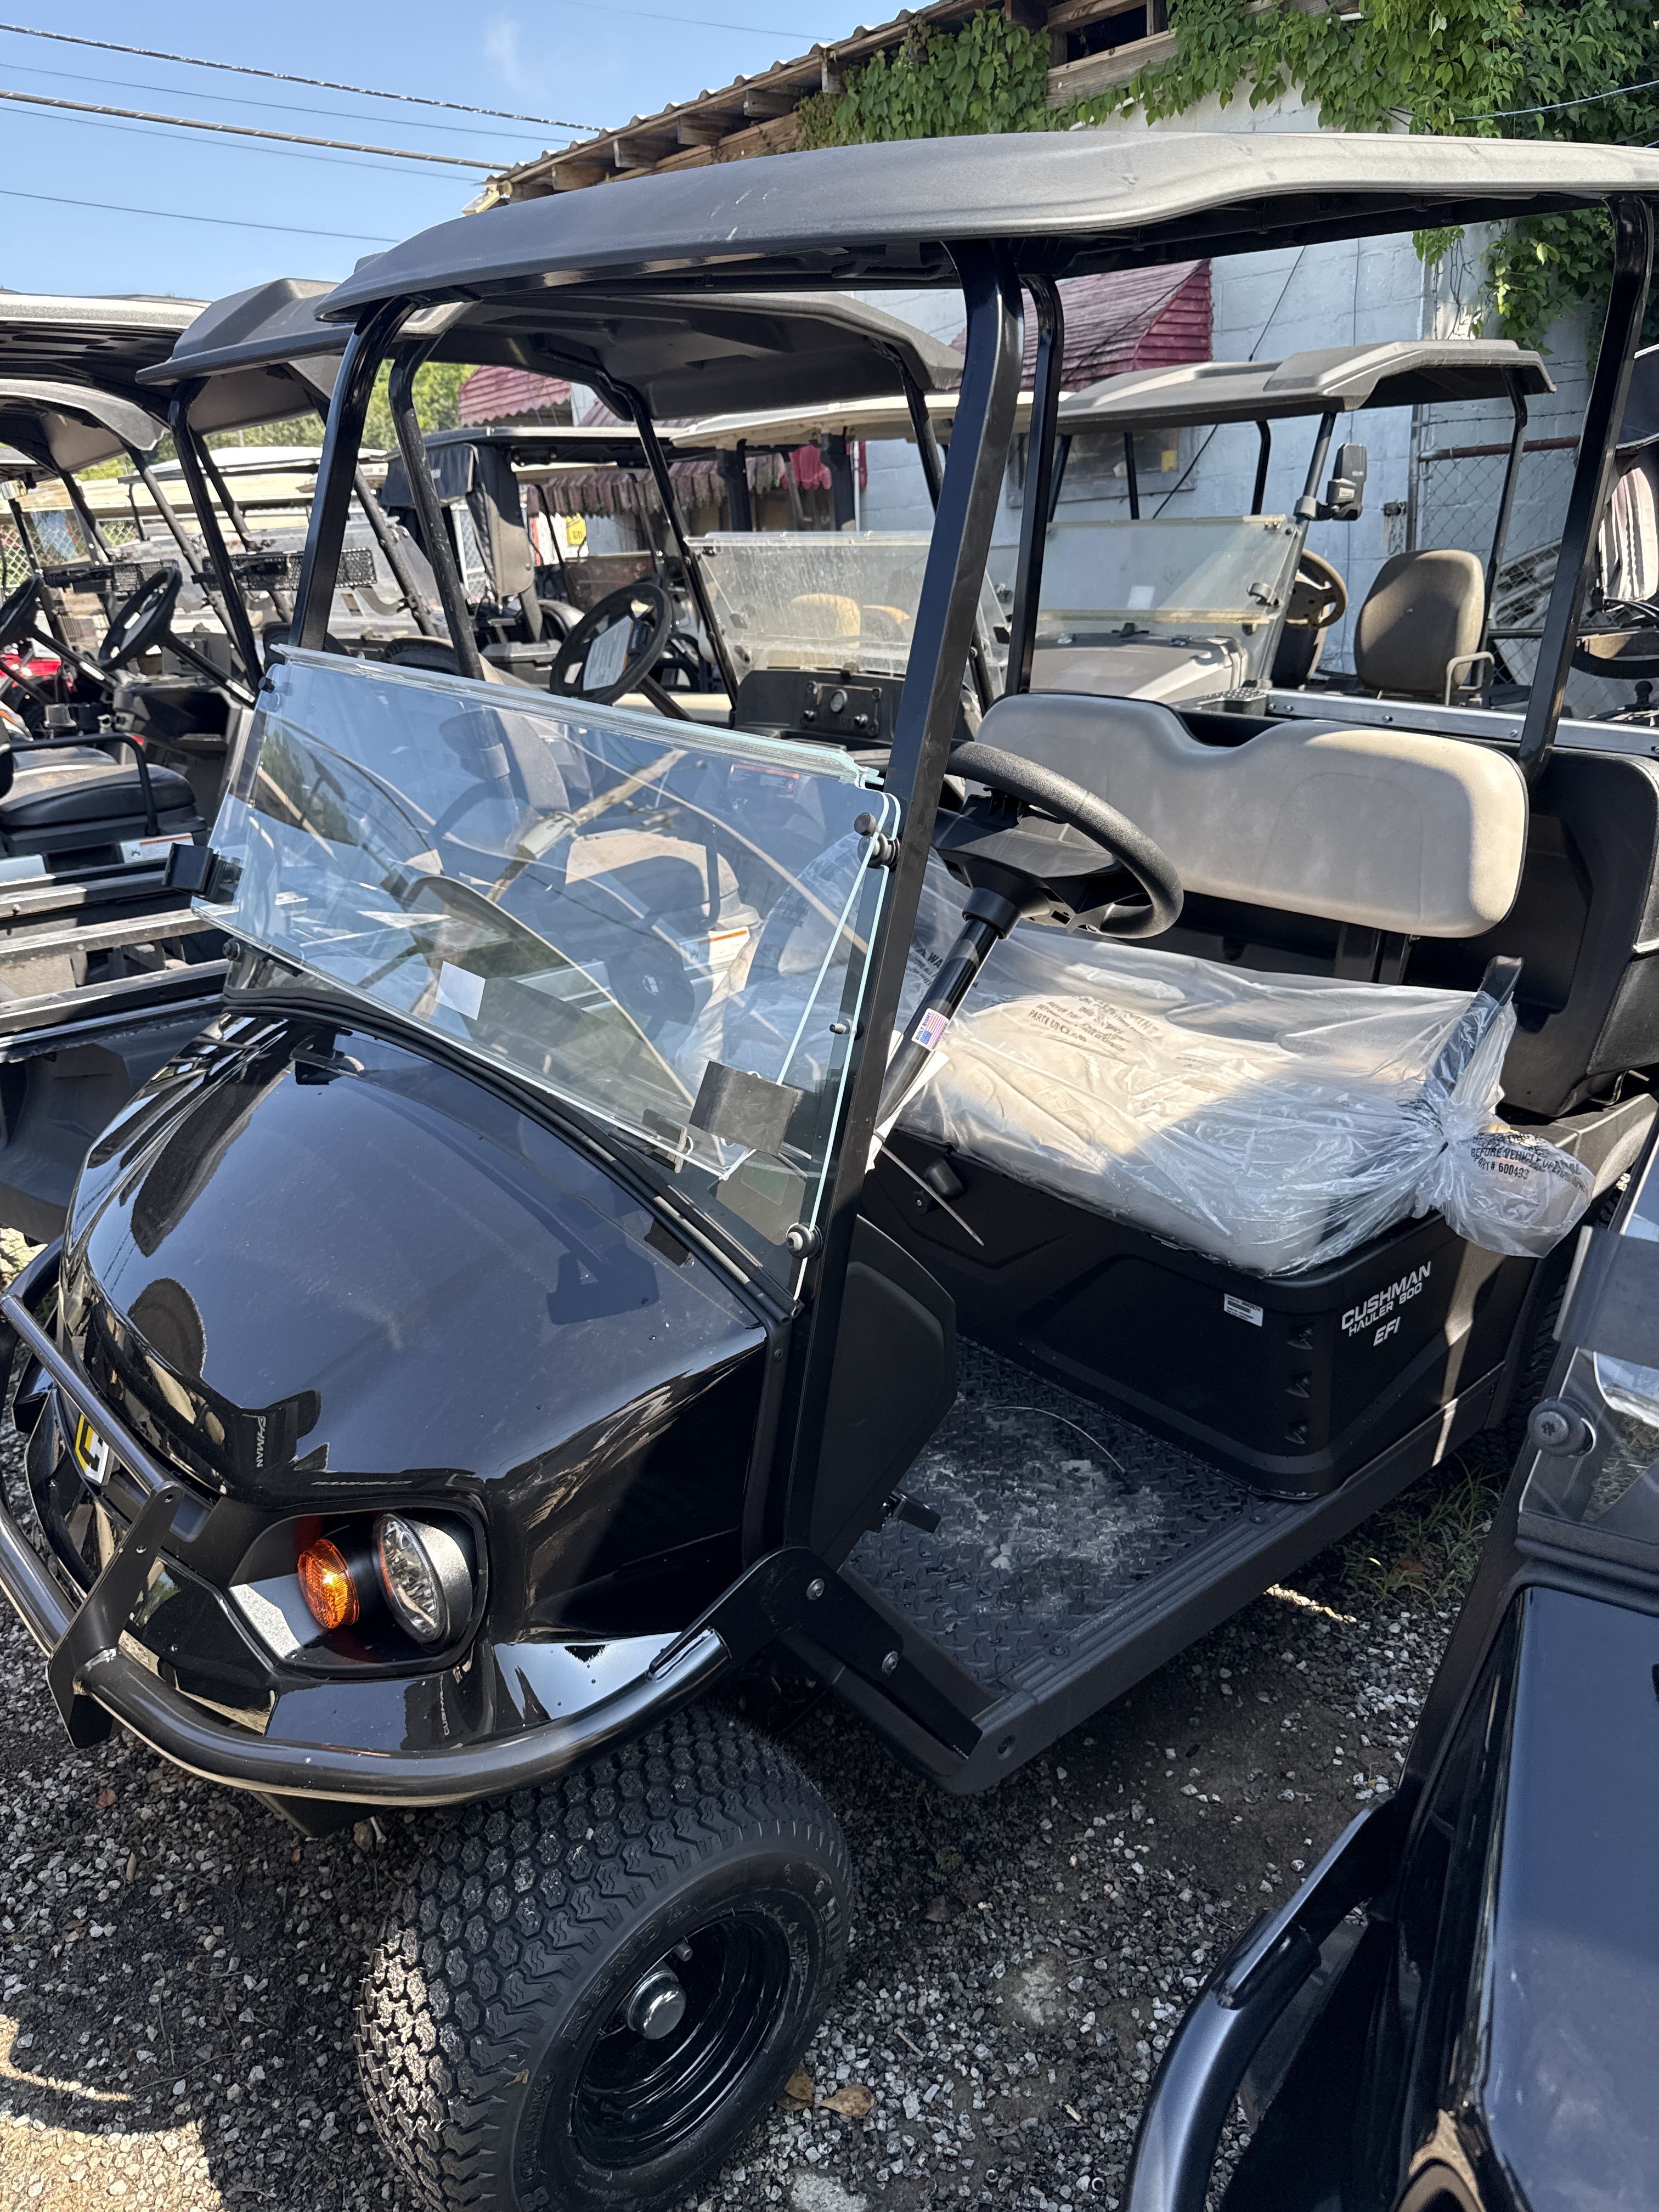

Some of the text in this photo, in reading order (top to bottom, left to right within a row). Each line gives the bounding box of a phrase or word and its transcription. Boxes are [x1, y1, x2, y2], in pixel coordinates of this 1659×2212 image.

[915, 1026, 925, 1041] BUILT
[1471, 1146, 1504, 1158] BEFORE
[1341, 1261, 1431, 1330] CUSHMAN
[1348, 1282, 1422, 1337] HAULER 800
[1373, 1316, 1401, 1347] EFI
[439, 1674, 450, 1735] CUSH
[560, 1896, 695, 2040] KENDA
